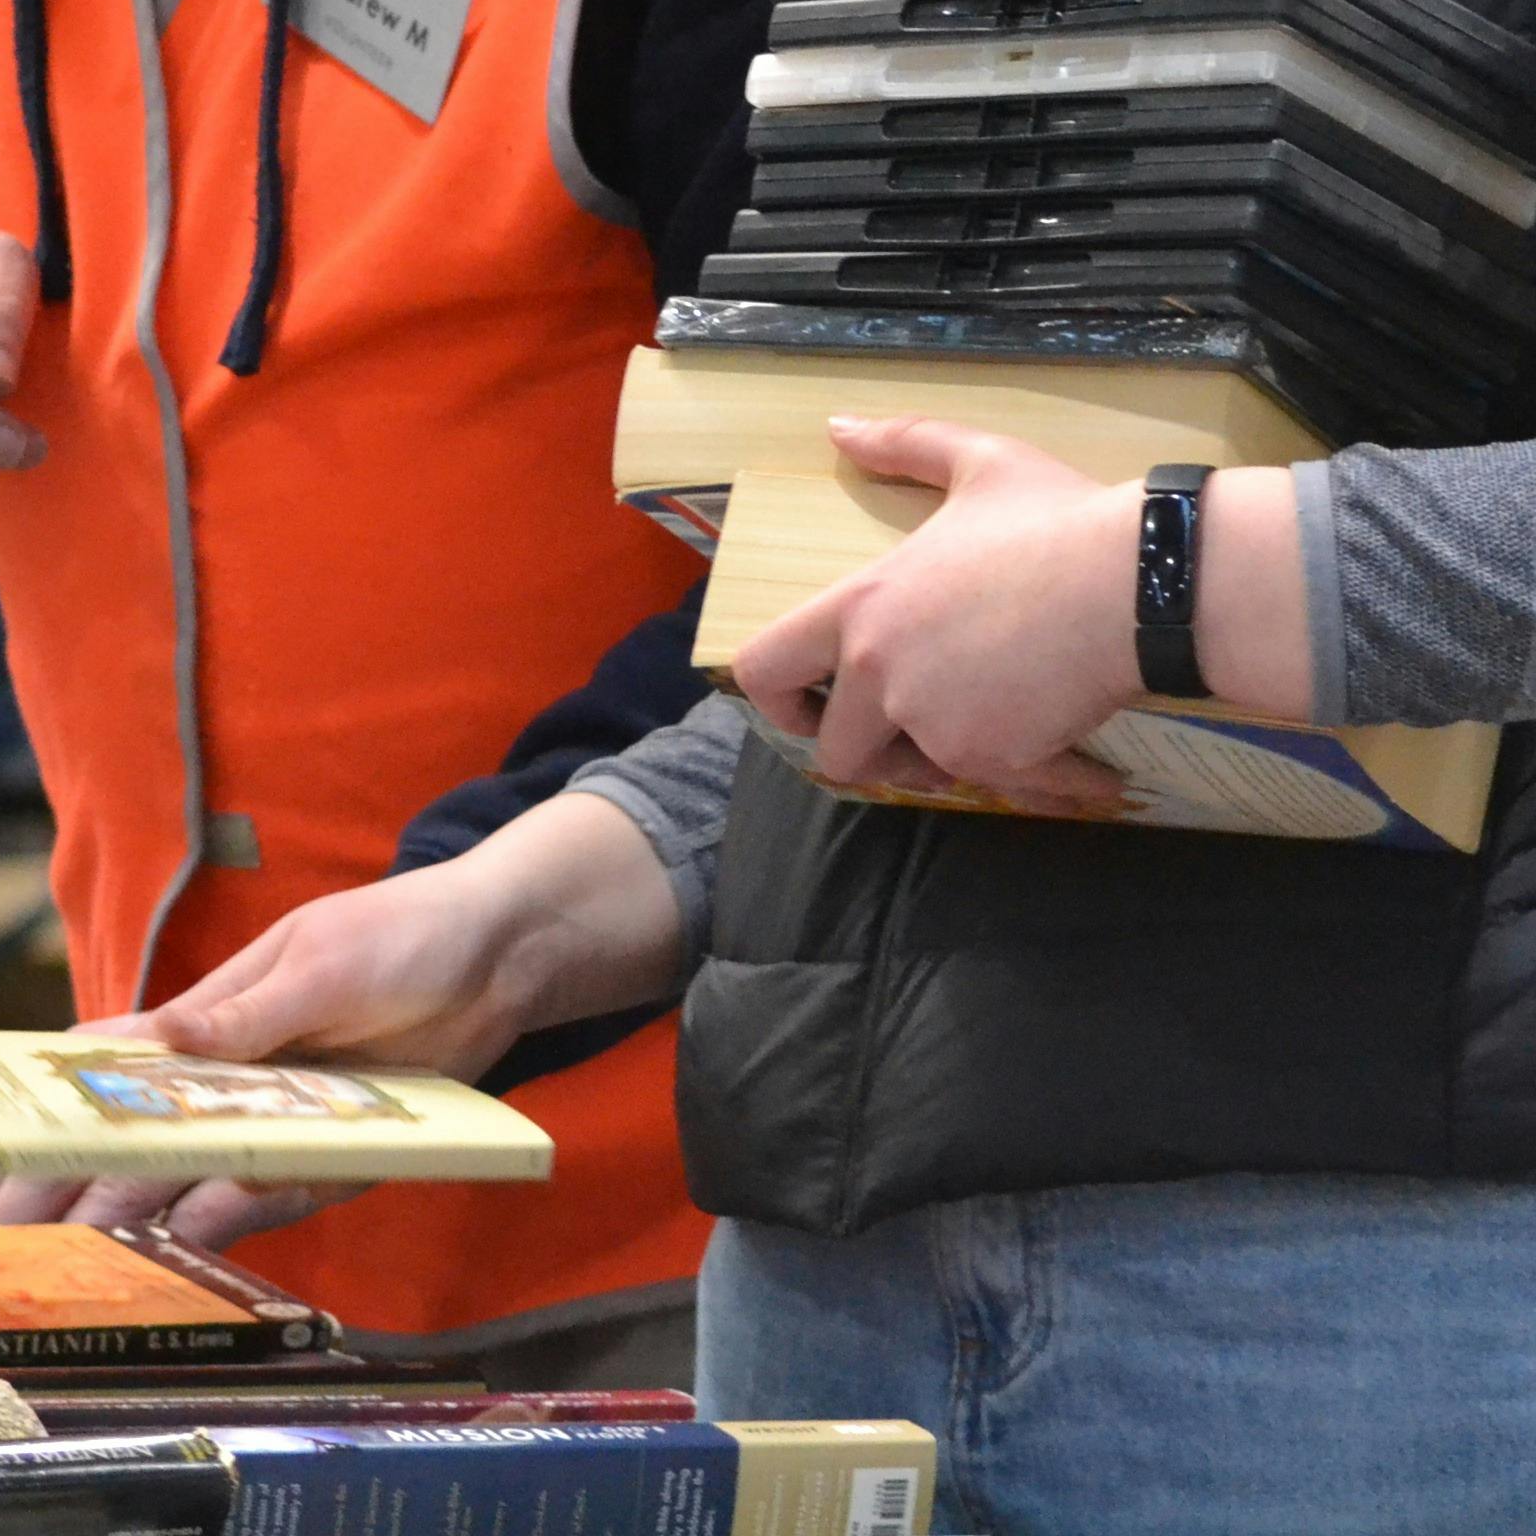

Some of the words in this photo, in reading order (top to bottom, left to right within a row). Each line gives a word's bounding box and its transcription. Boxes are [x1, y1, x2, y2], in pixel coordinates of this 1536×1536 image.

[405, 19, 430, 54] M
[188, 1329, 234, 1349] Lewis
[384, 1426, 572, 1445] MISSION
[32, 1444, 155, 1464] MENEN
